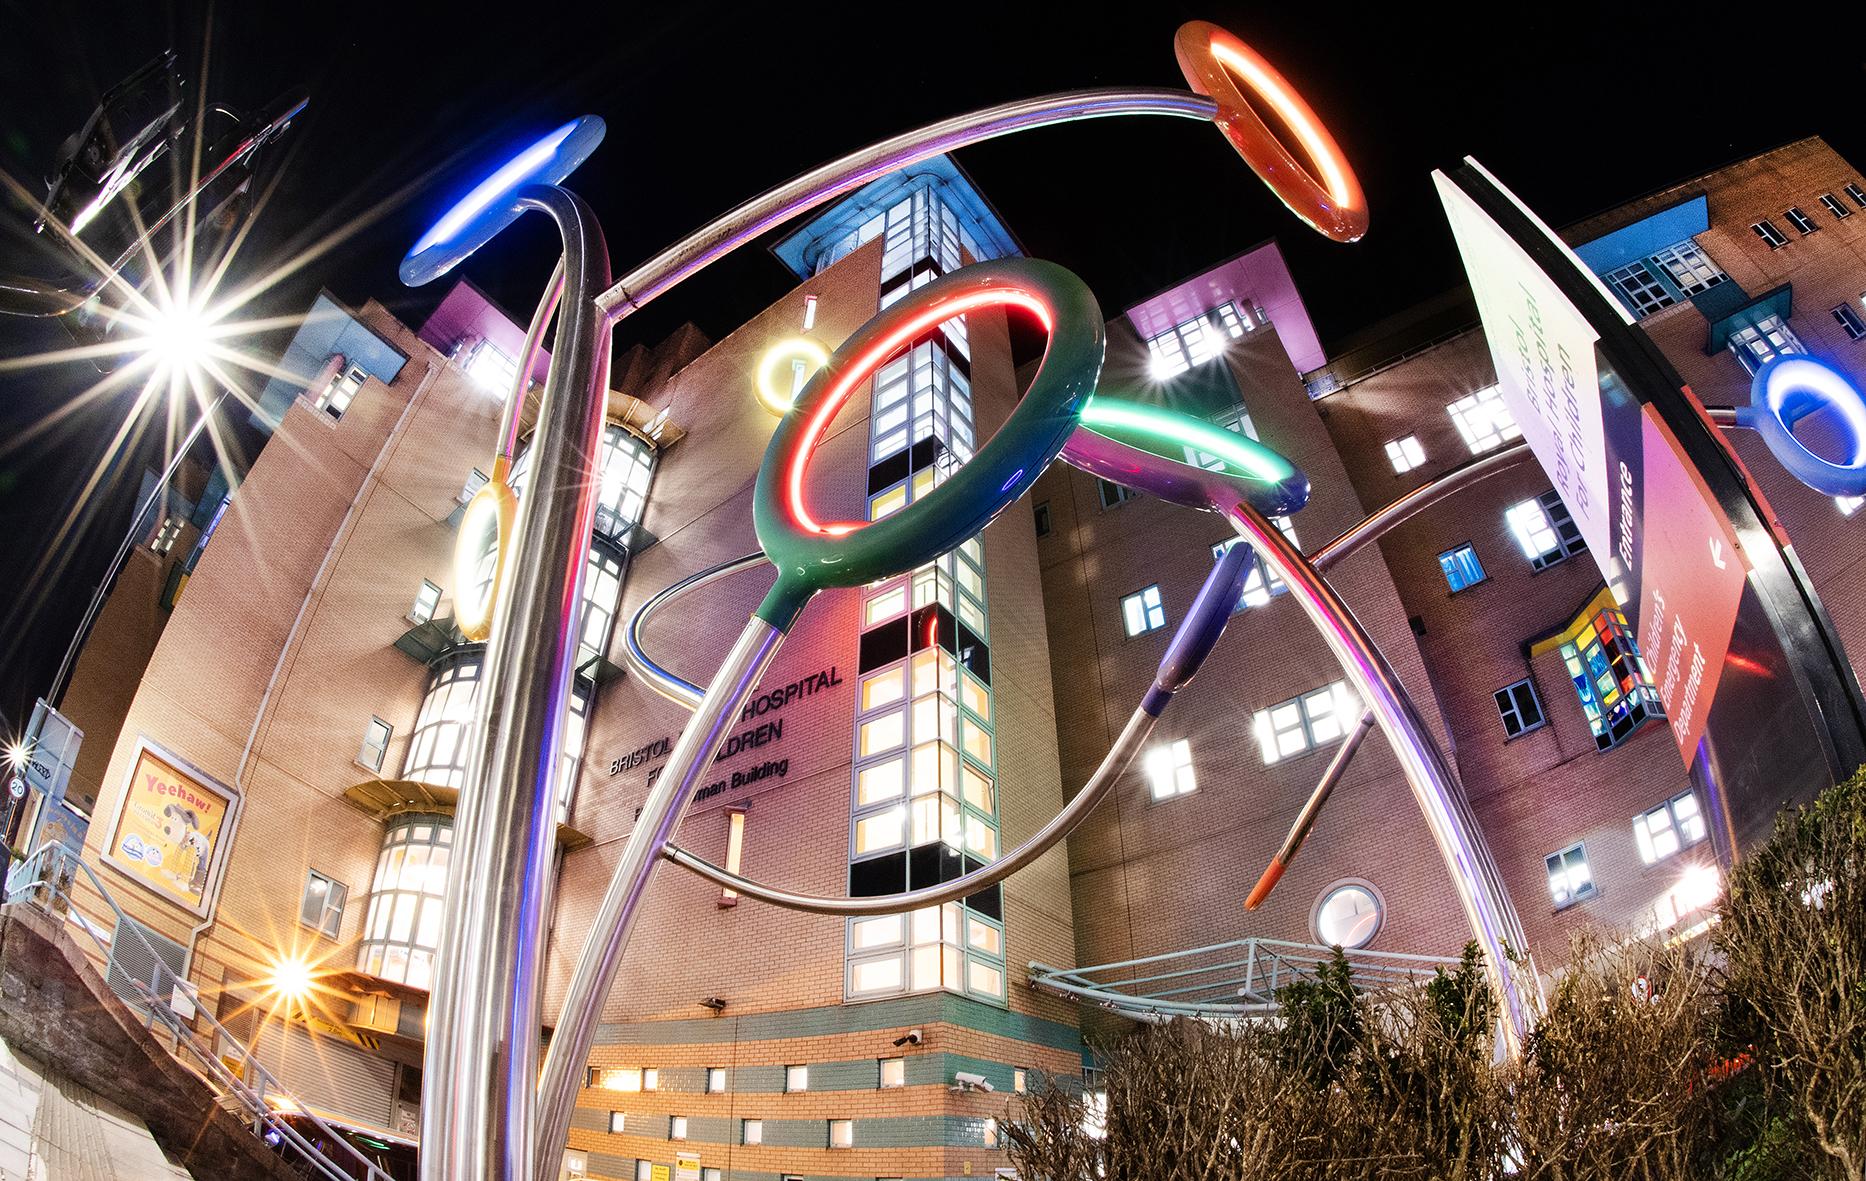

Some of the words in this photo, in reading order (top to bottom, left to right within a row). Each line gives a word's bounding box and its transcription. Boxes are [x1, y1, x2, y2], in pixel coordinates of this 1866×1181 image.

[1508, 315, 1541, 414] Bristol
[1518, 281, 1559, 421] Hospital
[1557, 343, 1586, 473] Children
[1547, 415, 1570, 498] Royal
[1576, 470, 1590, 521] for
[1618, 461, 1634, 571] Entrance
[1646, 588, 1665, 675] Children's
[1659, 614, 1688, 711] Emergency
[609, 737, 673, 776] BRISTOL
[741, 666, 843, 722] HOSPITAL
[1673, 641, 1706, 746] Department
[713, 718, 783, 763] LDREN
[731, 758, 788, 789] Building
[11, 781, 23, 795] 20
[145, 773, 211, 814] Yeehaw!
